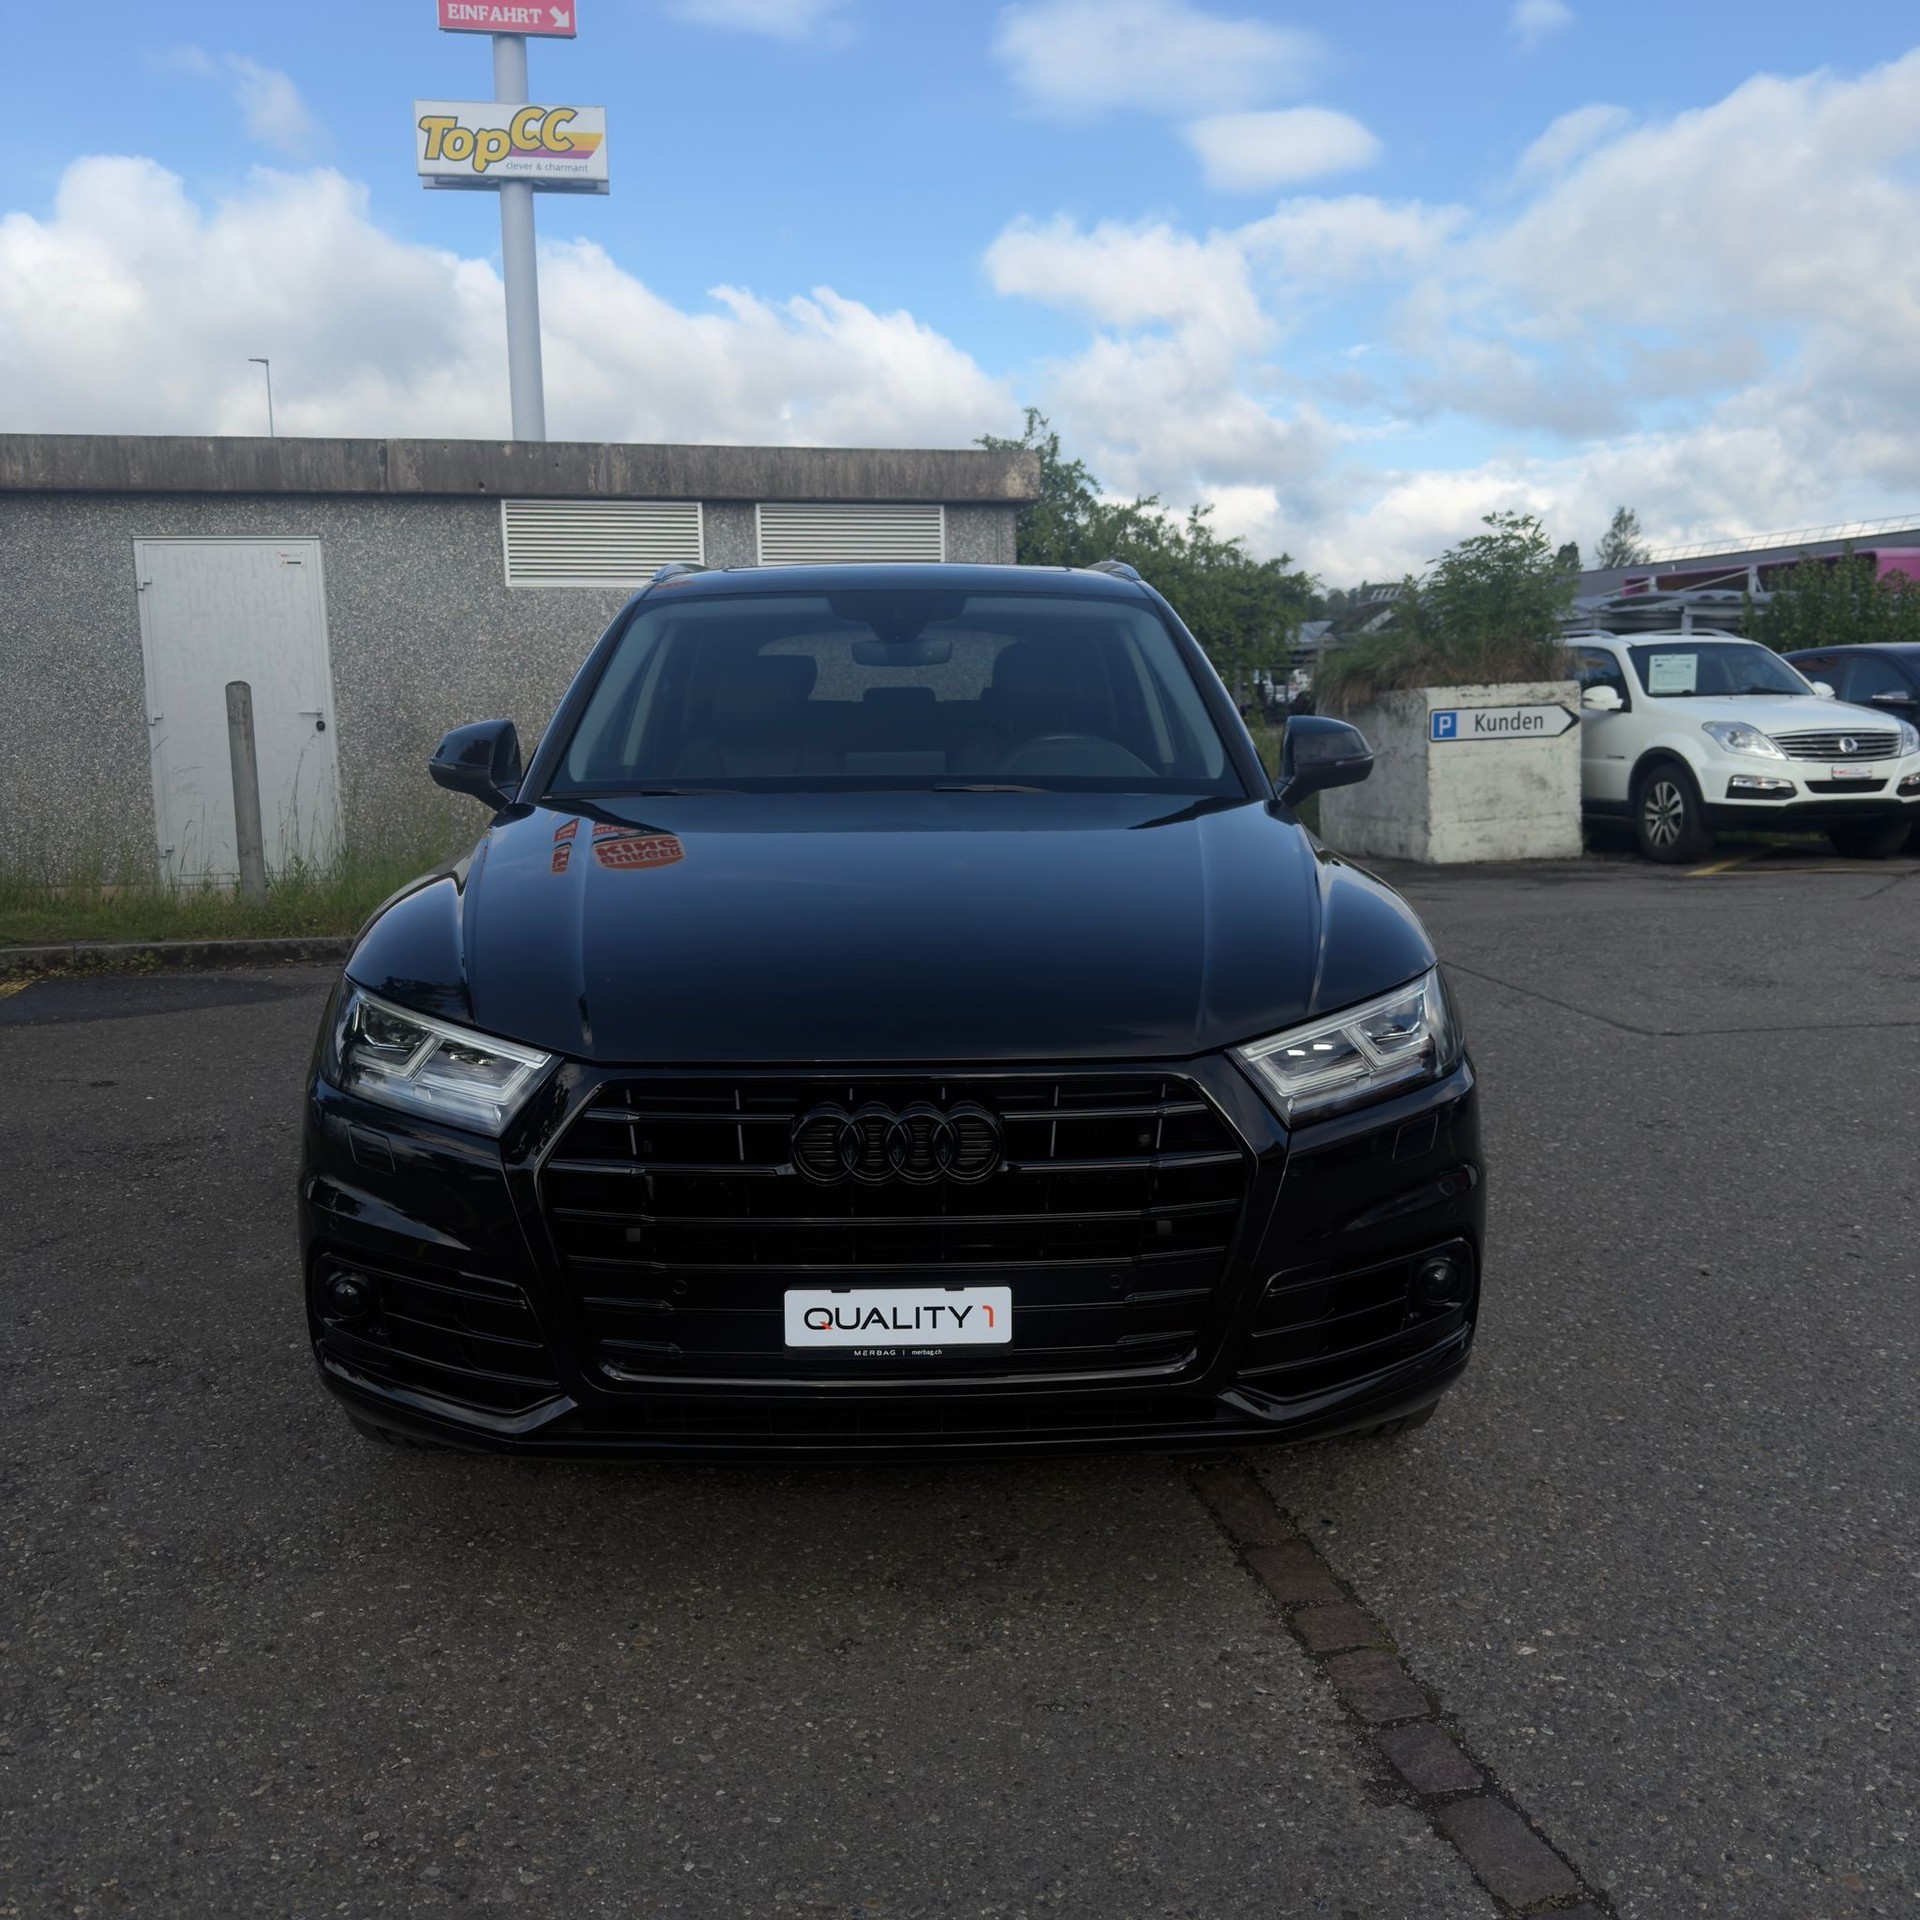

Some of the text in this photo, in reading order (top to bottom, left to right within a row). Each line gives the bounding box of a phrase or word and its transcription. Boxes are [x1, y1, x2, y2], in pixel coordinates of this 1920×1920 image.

[447, 3, 542, 25] EINFAHRT
[418, 106, 579, 174] TopCC
[506, 161, 589, 173] clever & charmant
[1474, 711, 1544, 732] Kunden
[803, 1305, 974, 1330] QUALITY
[853, 1349, 943, 1357] MERBAG merbag.ch
